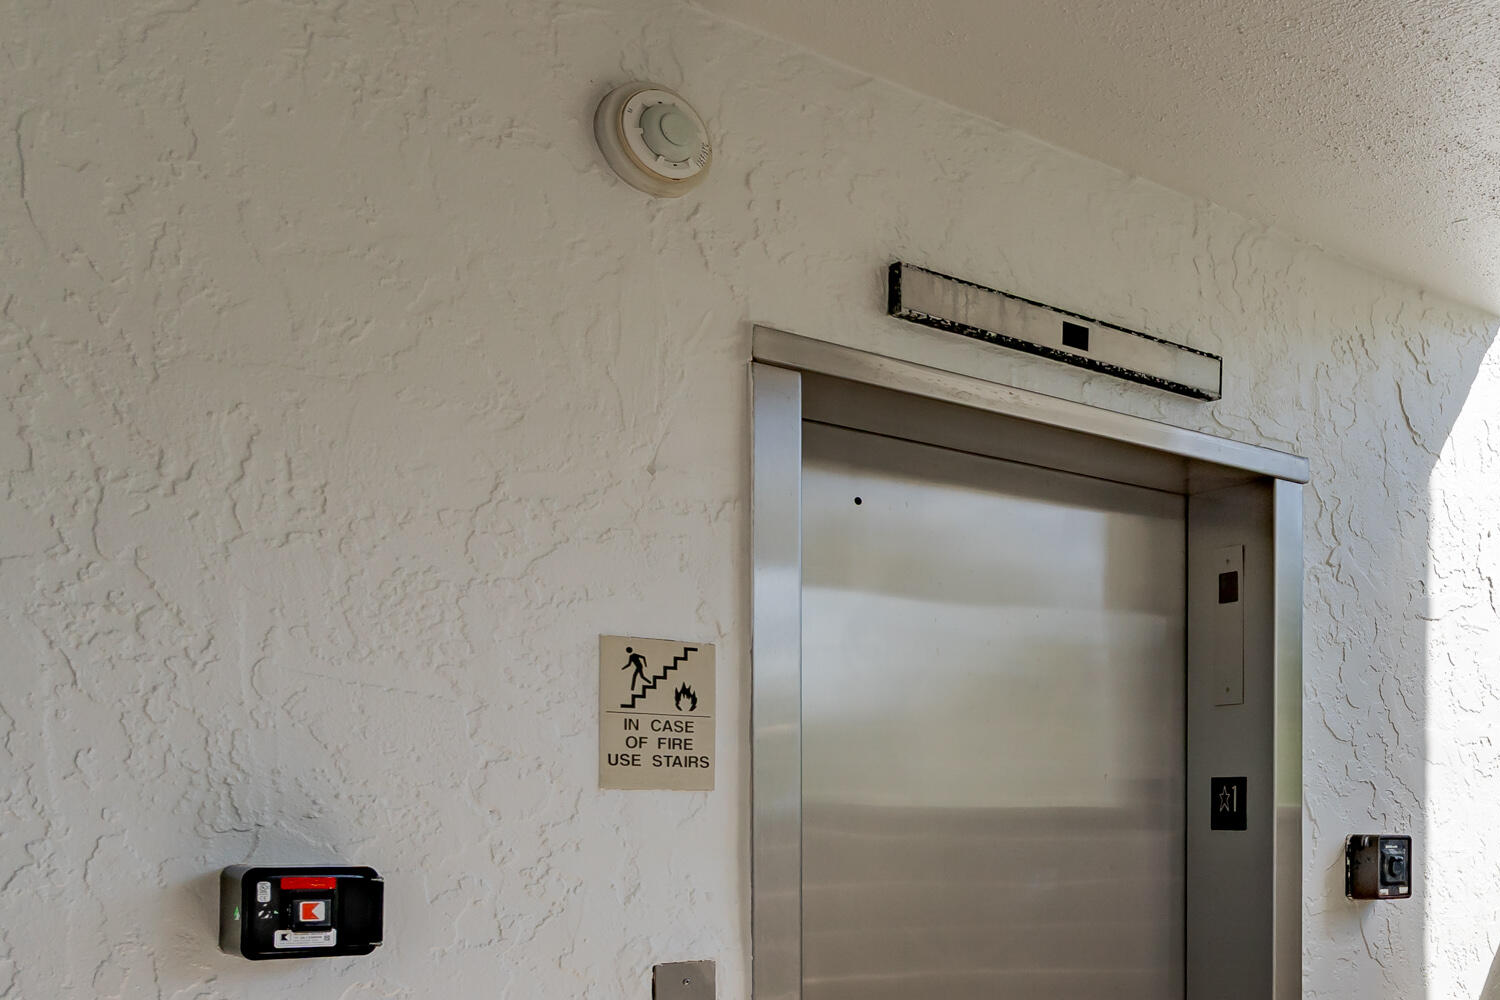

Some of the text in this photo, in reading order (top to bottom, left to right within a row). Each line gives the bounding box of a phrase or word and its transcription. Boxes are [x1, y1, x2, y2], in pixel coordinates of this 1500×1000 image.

[624, 718, 694, 733] IN CASE
[625, 736, 693, 750] OF FIRE
[608, 753, 710, 768] USE STAIRS
[1231, 785, 1237, 812] 1
